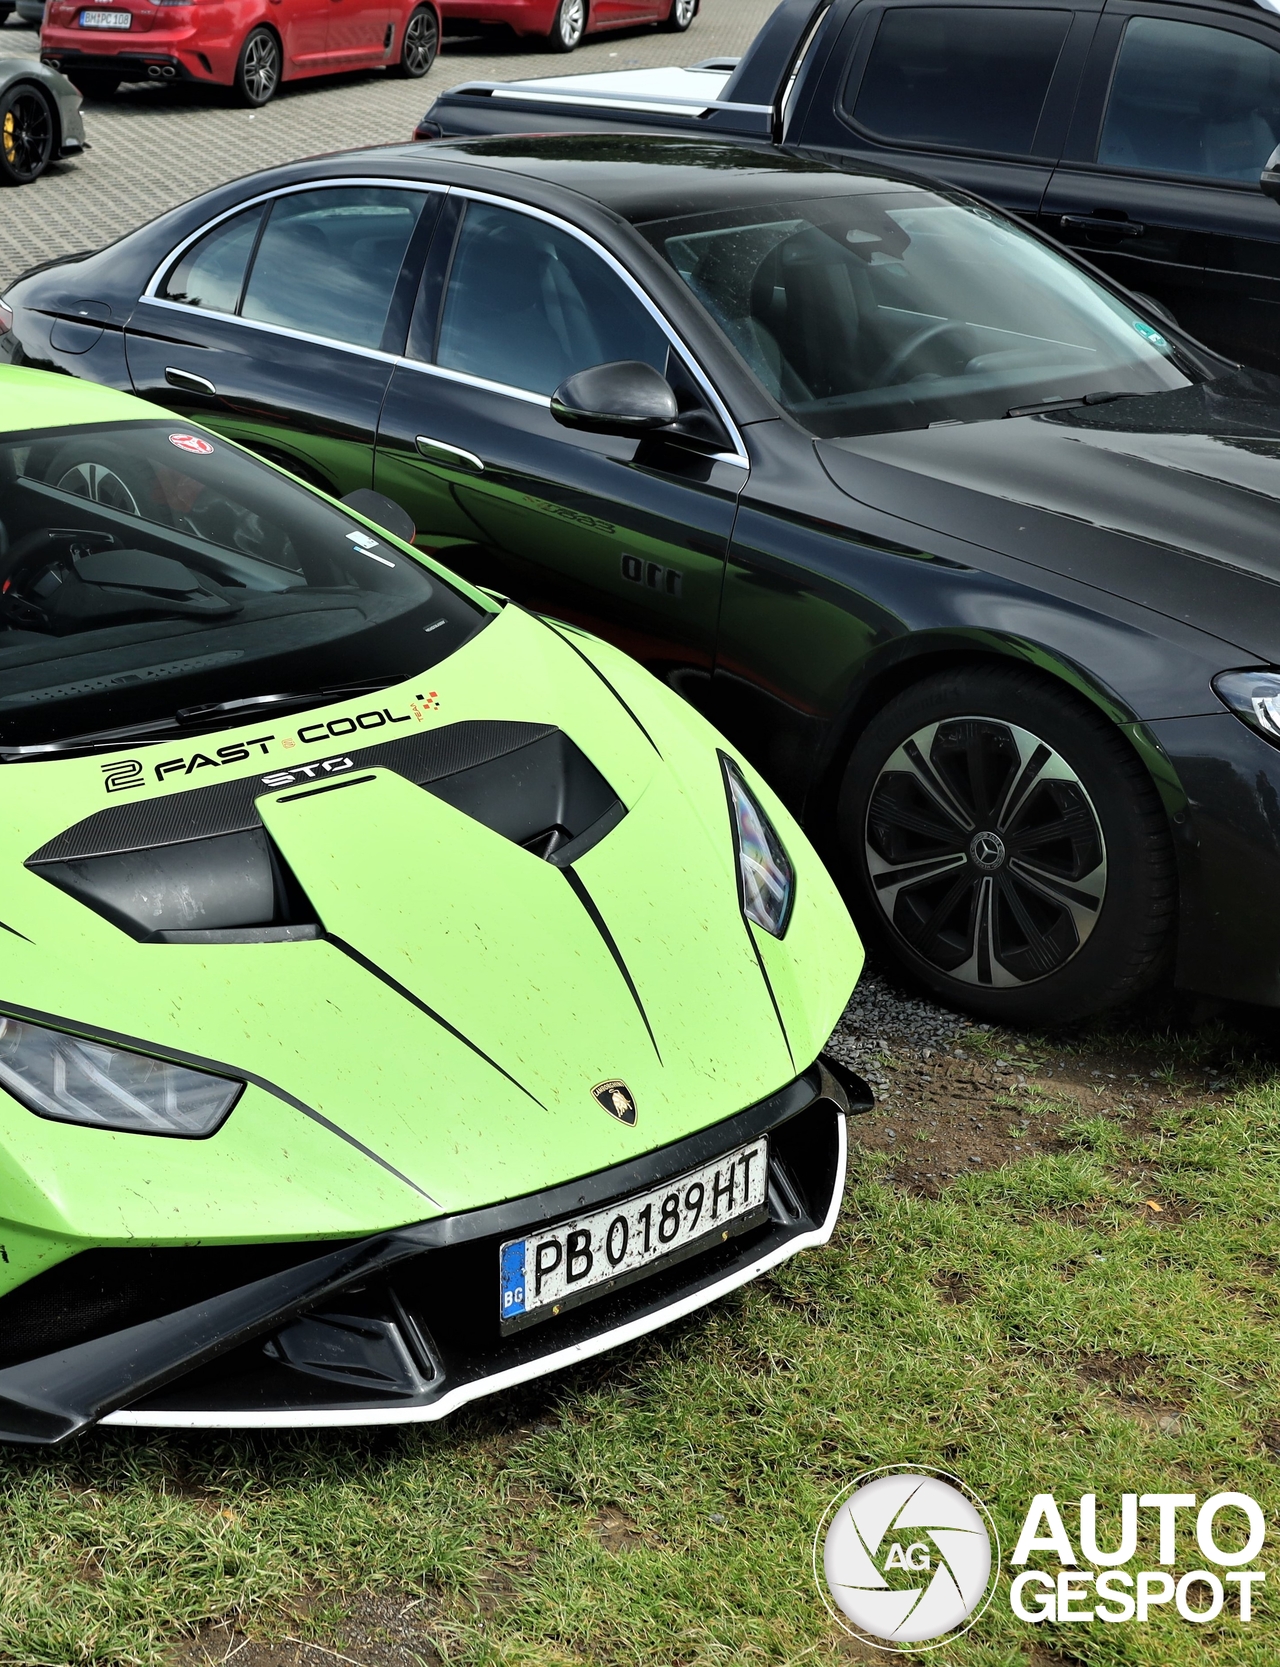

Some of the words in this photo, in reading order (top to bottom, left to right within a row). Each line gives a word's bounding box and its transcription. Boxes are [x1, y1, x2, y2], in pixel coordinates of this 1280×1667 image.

[85, 12, 97, 23] BM
[100, 13, 112, 24] PC
[113, 14, 129, 25] 108
[101, 759, 145, 793] 2
[154, 735, 275, 782] FAST
[297, 708, 411, 744] COOL
[261, 757, 354, 787] STO
[535, 1228, 593, 1297] PB
[606, 1182, 705, 1266] 0189
[711, 1149, 759, 1220] HT
[504, 1286, 523, 1308] BG
